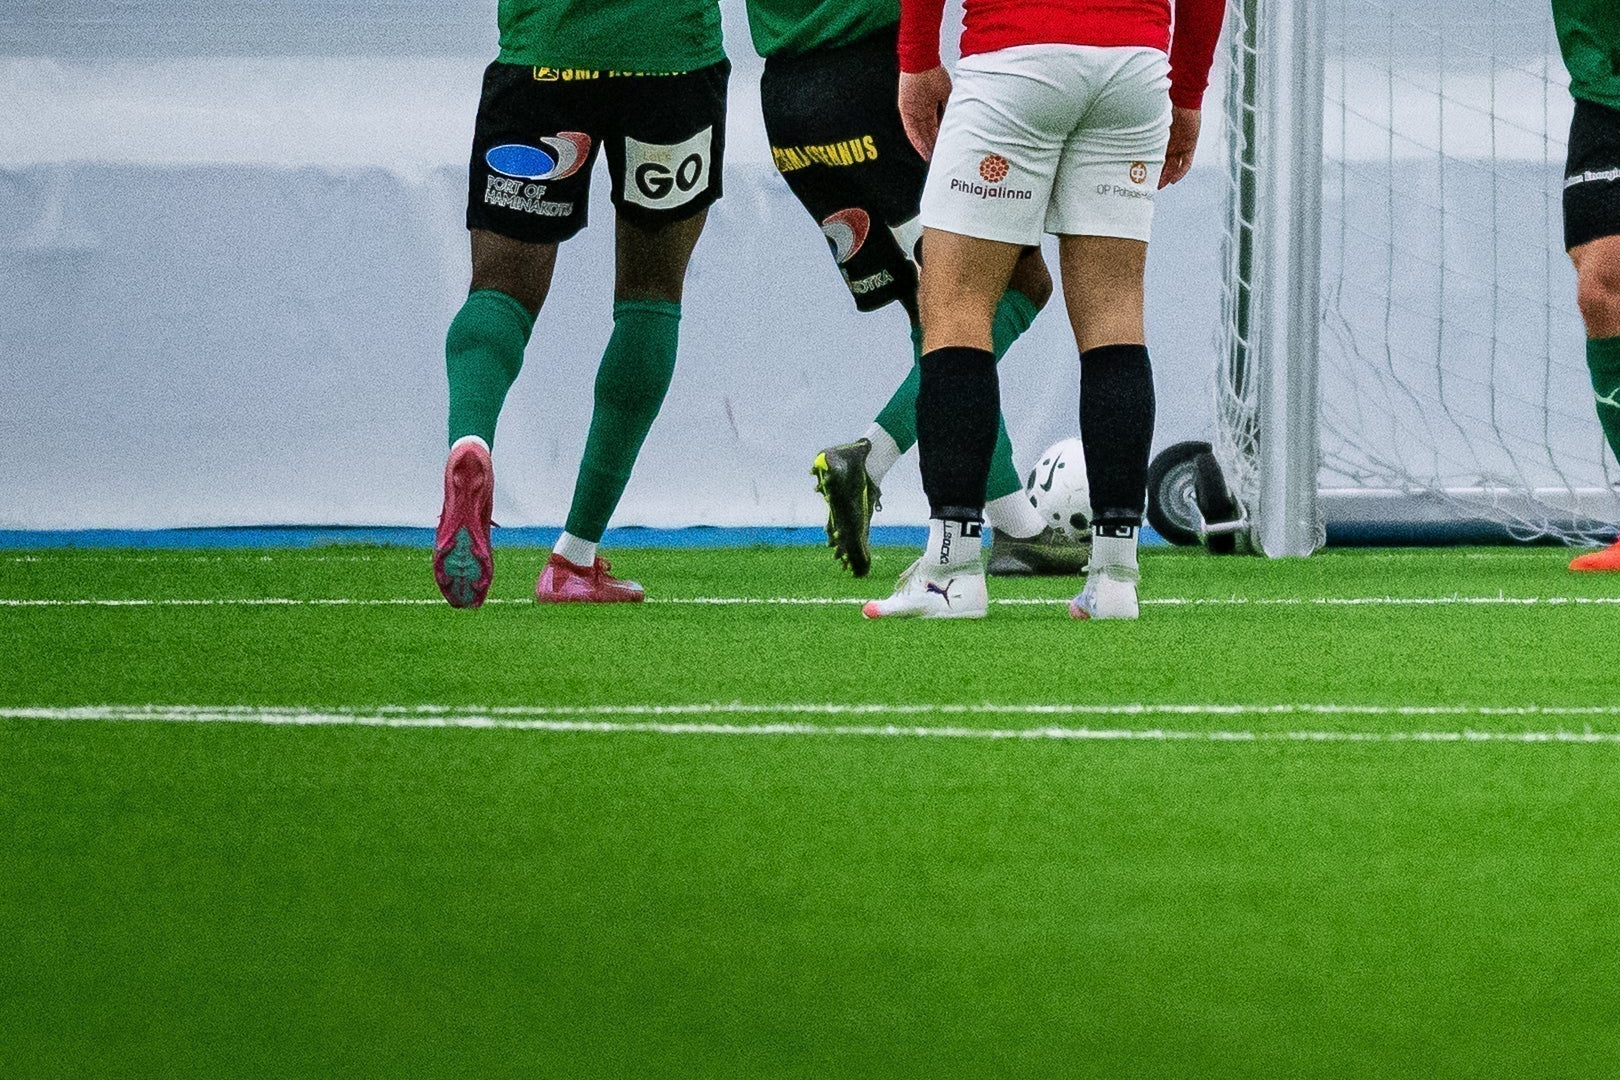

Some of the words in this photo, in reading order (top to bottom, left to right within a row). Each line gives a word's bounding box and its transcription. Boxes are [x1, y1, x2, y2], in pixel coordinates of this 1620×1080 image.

[488, 174, 523, 195] PORT
[524, 183, 547, 199] OF
[635, 152, 703, 200] GO
[950, 178, 1032, 200] Pihlajalinna
[1096, 183, 1111, 195] OP
